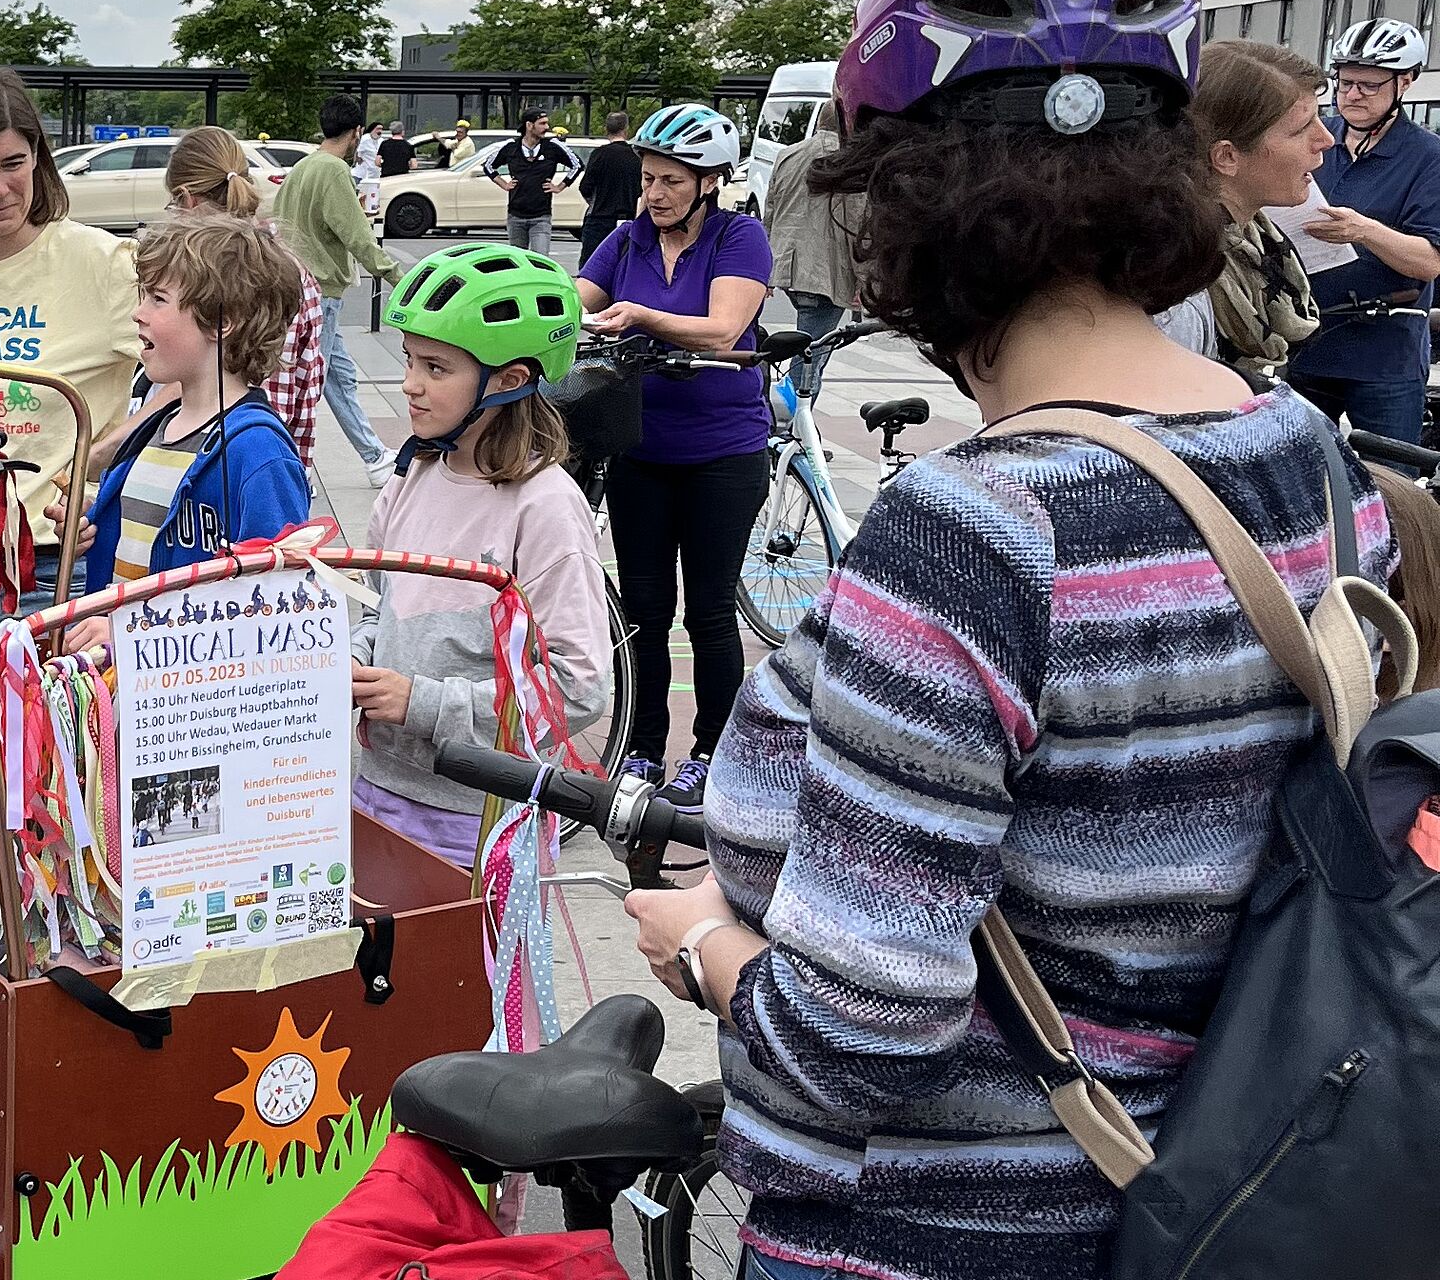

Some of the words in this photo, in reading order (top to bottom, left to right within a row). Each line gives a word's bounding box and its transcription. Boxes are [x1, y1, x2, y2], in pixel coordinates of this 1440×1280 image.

[863, 26, 891, 59] ABUS
[134, 628, 244, 671] KIDICAL
[256, 617, 334, 656] MASS
[135, 676, 156, 692] AM
[161, 663, 245, 689] 07.05.2023
[251, 659, 265, 677] IN
[270, 652, 337, 674] DUISBURG
[135, 697, 166, 712] 14.30
[168, 693, 187, 707] Uhr
[191, 686, 236, 703] Neudorf
[238, 679, 307, 697] Ludgeriplatz
[135, 716, 165, 730] 15.00
[168, 711, 187, 725] Uhr
[190, 703, 237, 722] Duisburg
[240, 693, 319, 716] Hauptbahnhof
[135, 734, 165, 748] 15.00
[167, 729, 187, 743] Uhr
[189, 722, 230, 740] Wedau,
[232, 717, 282, 734] Wedauer
[284, 712, 317, 726] Markt
[135, 751, 166, 767] 15.30
[169, 747, 188, 761] Uhr
[191, 738, 260, 758] Bissingheim,
[262, 728, 332, 748] Grundschule
[272, 755, 290, 768] Für
[291, 754, 308, 766] ein
[243, 768, 337, 790] kinderfreundliches
[246, 795, 266, 808] und
[268, 787, 335, 805] lebenswertes
[153, 934, 182, 949] adfc
